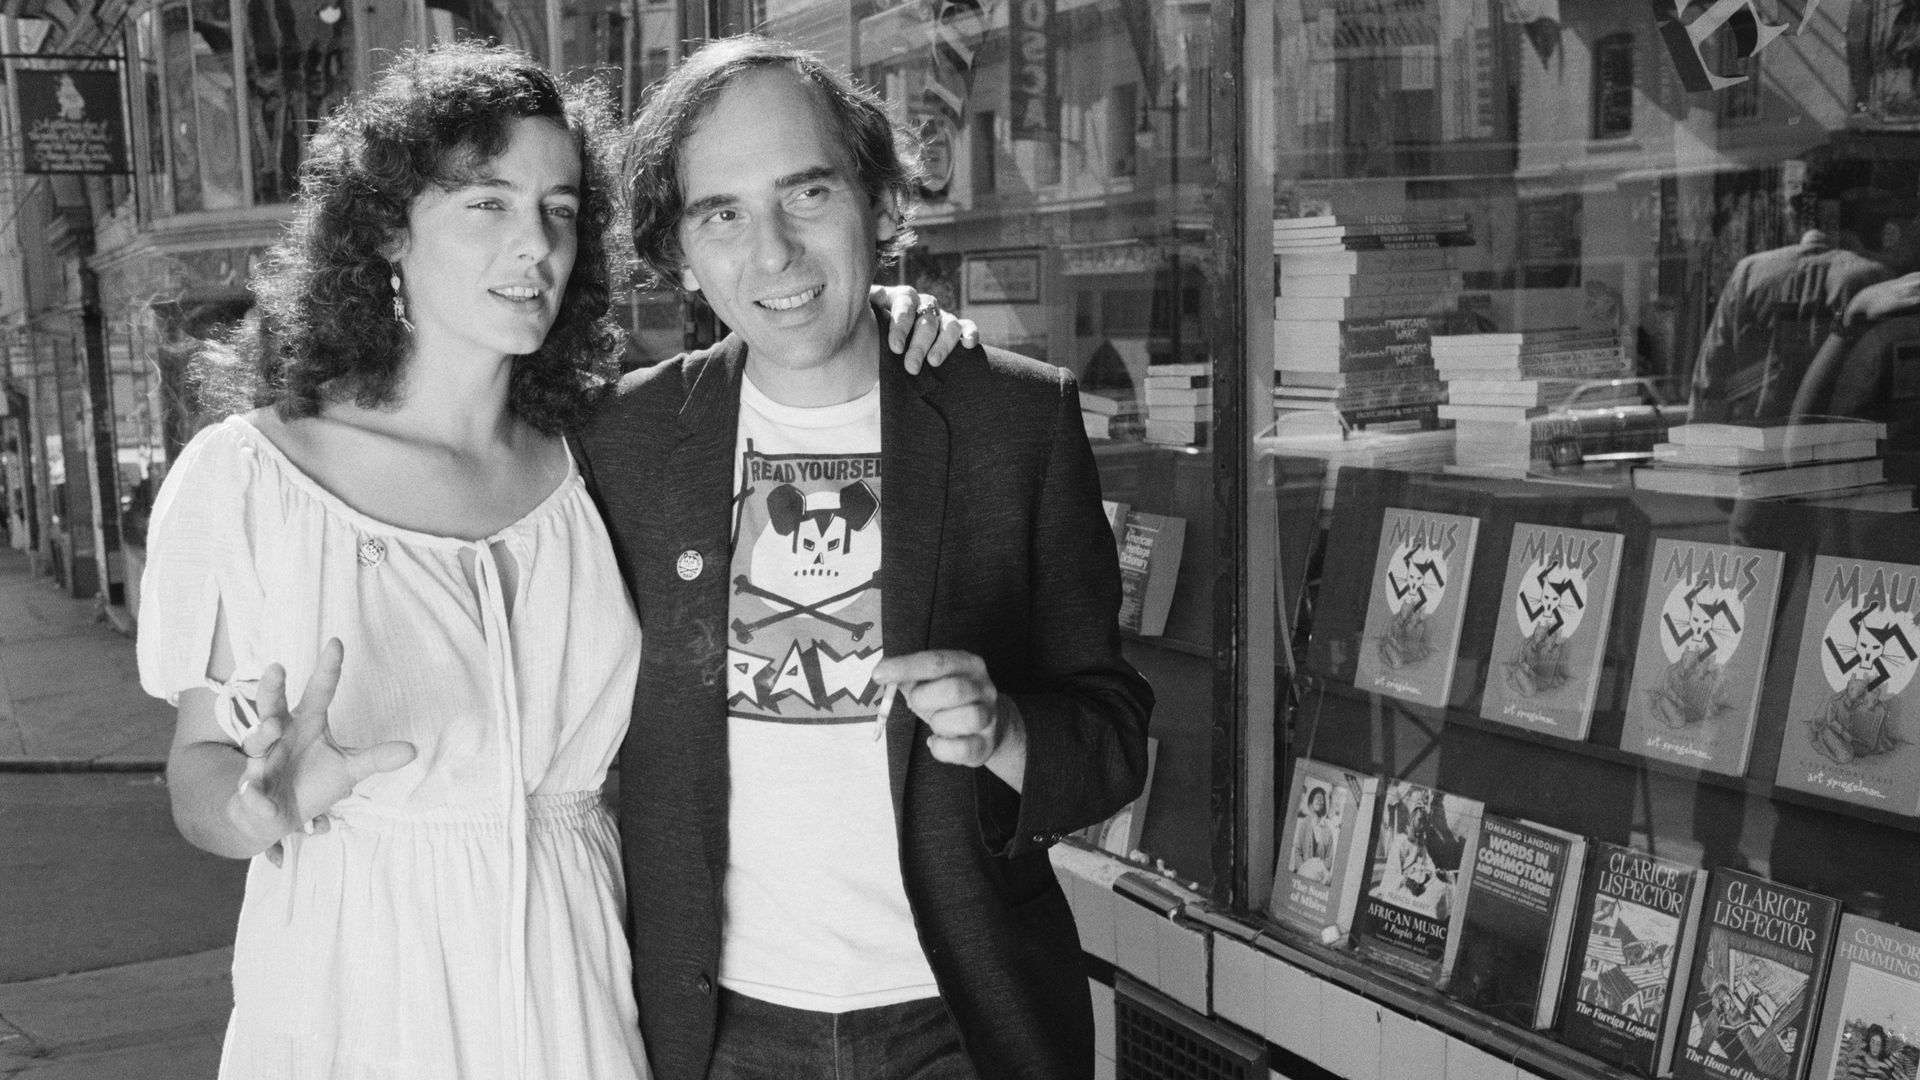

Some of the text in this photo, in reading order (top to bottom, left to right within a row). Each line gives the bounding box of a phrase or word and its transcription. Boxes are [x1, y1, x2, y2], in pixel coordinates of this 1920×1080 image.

[751, 460, 796, 484] READ
[1388, 515, 1460, 561] MAUS
[1519, 529, 1603, 581] MAUS
[1662, 546, 1761, 602] MAUS
[1824, 563, 1920, 626] MAU
[727, 638, 884, 711] RAW
[1807, 770, 1824, 784] art
[1826, 775, 1886, 799] spiegelman
[1484, 820, 1561, 855] TOMMASO LANDOLFI
[1489, 834, 1550, 870] WORDS IN
[1292, 878, 1308, 894] The
[1475, 861, 1494, 876] AND
[1493, 868, 1520, 886] OTHER
[1518, 877, 1552, 898] STORIES
[1478, 846, 1555, 888] COMMOTION
[1609, 852, 1680, 891] CLARICE
[1598, 870, 1683, 915] LISPECTOR
[1727, 880, 1811, 926] CLARICE
[1367, 901, 1447, 941] AFRICAN MUSIC
[1382, 921, 1390, 931] A
[1713, 900, 1817, 954] LISPECTOR
[1840, 941, 1920, 979] HUMMING
[1854, 926, 1920, 962] CONDOR
[1575, 1001, 1593, 1016] The
[1592, 1007, 1625, 1030] Foreign
[1625, 1020, 1657, 1041] Legion
[1685, 1047, 1704, 1064] The
[1703, 1055, 1731, 1074] Hour
[1729, 1067, 1745, 1079] of
